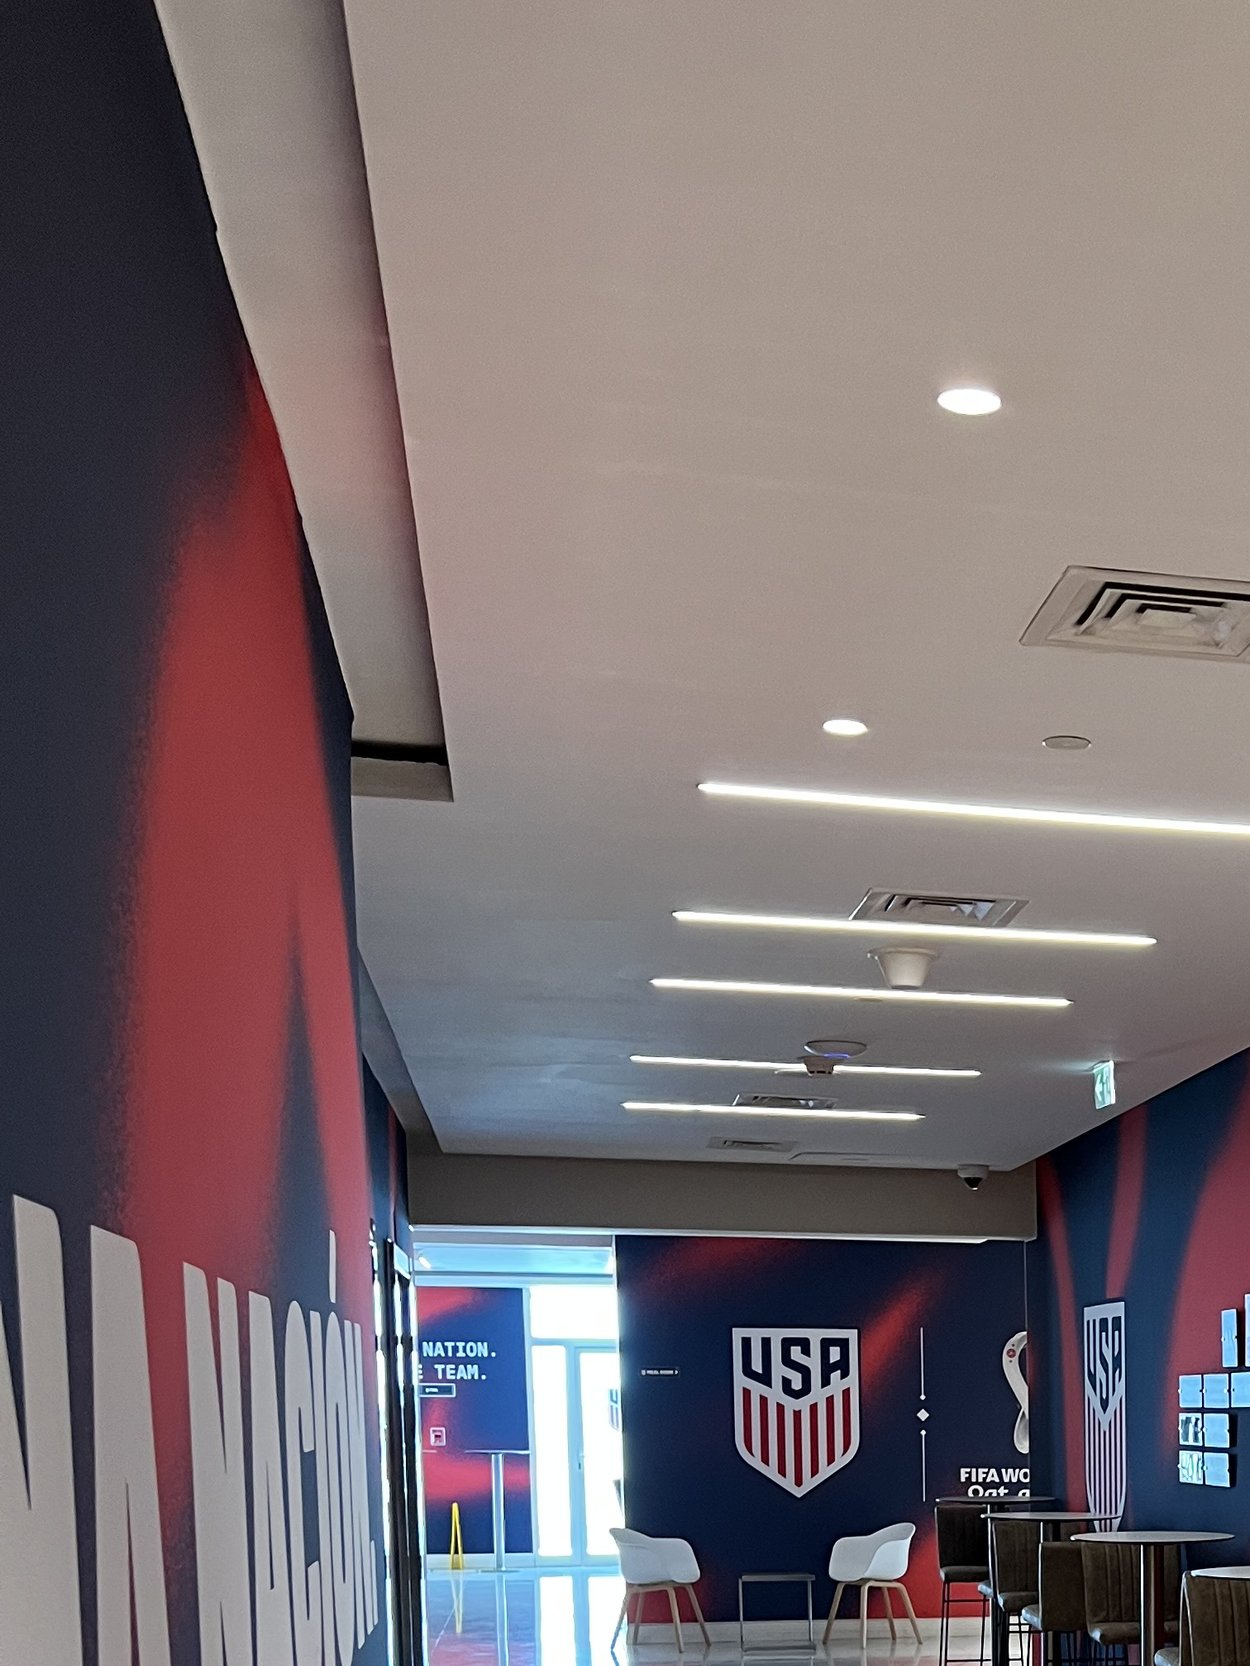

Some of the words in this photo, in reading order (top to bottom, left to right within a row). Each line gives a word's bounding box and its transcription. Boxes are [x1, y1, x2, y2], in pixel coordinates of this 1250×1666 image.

[422, 1341, 496, 1357] NATION.
[434, 1364, 486, 1380] TEAM.
[741, 1336, 850, 1400] USA
[960, 1468, 1000, 1482] FIFA
